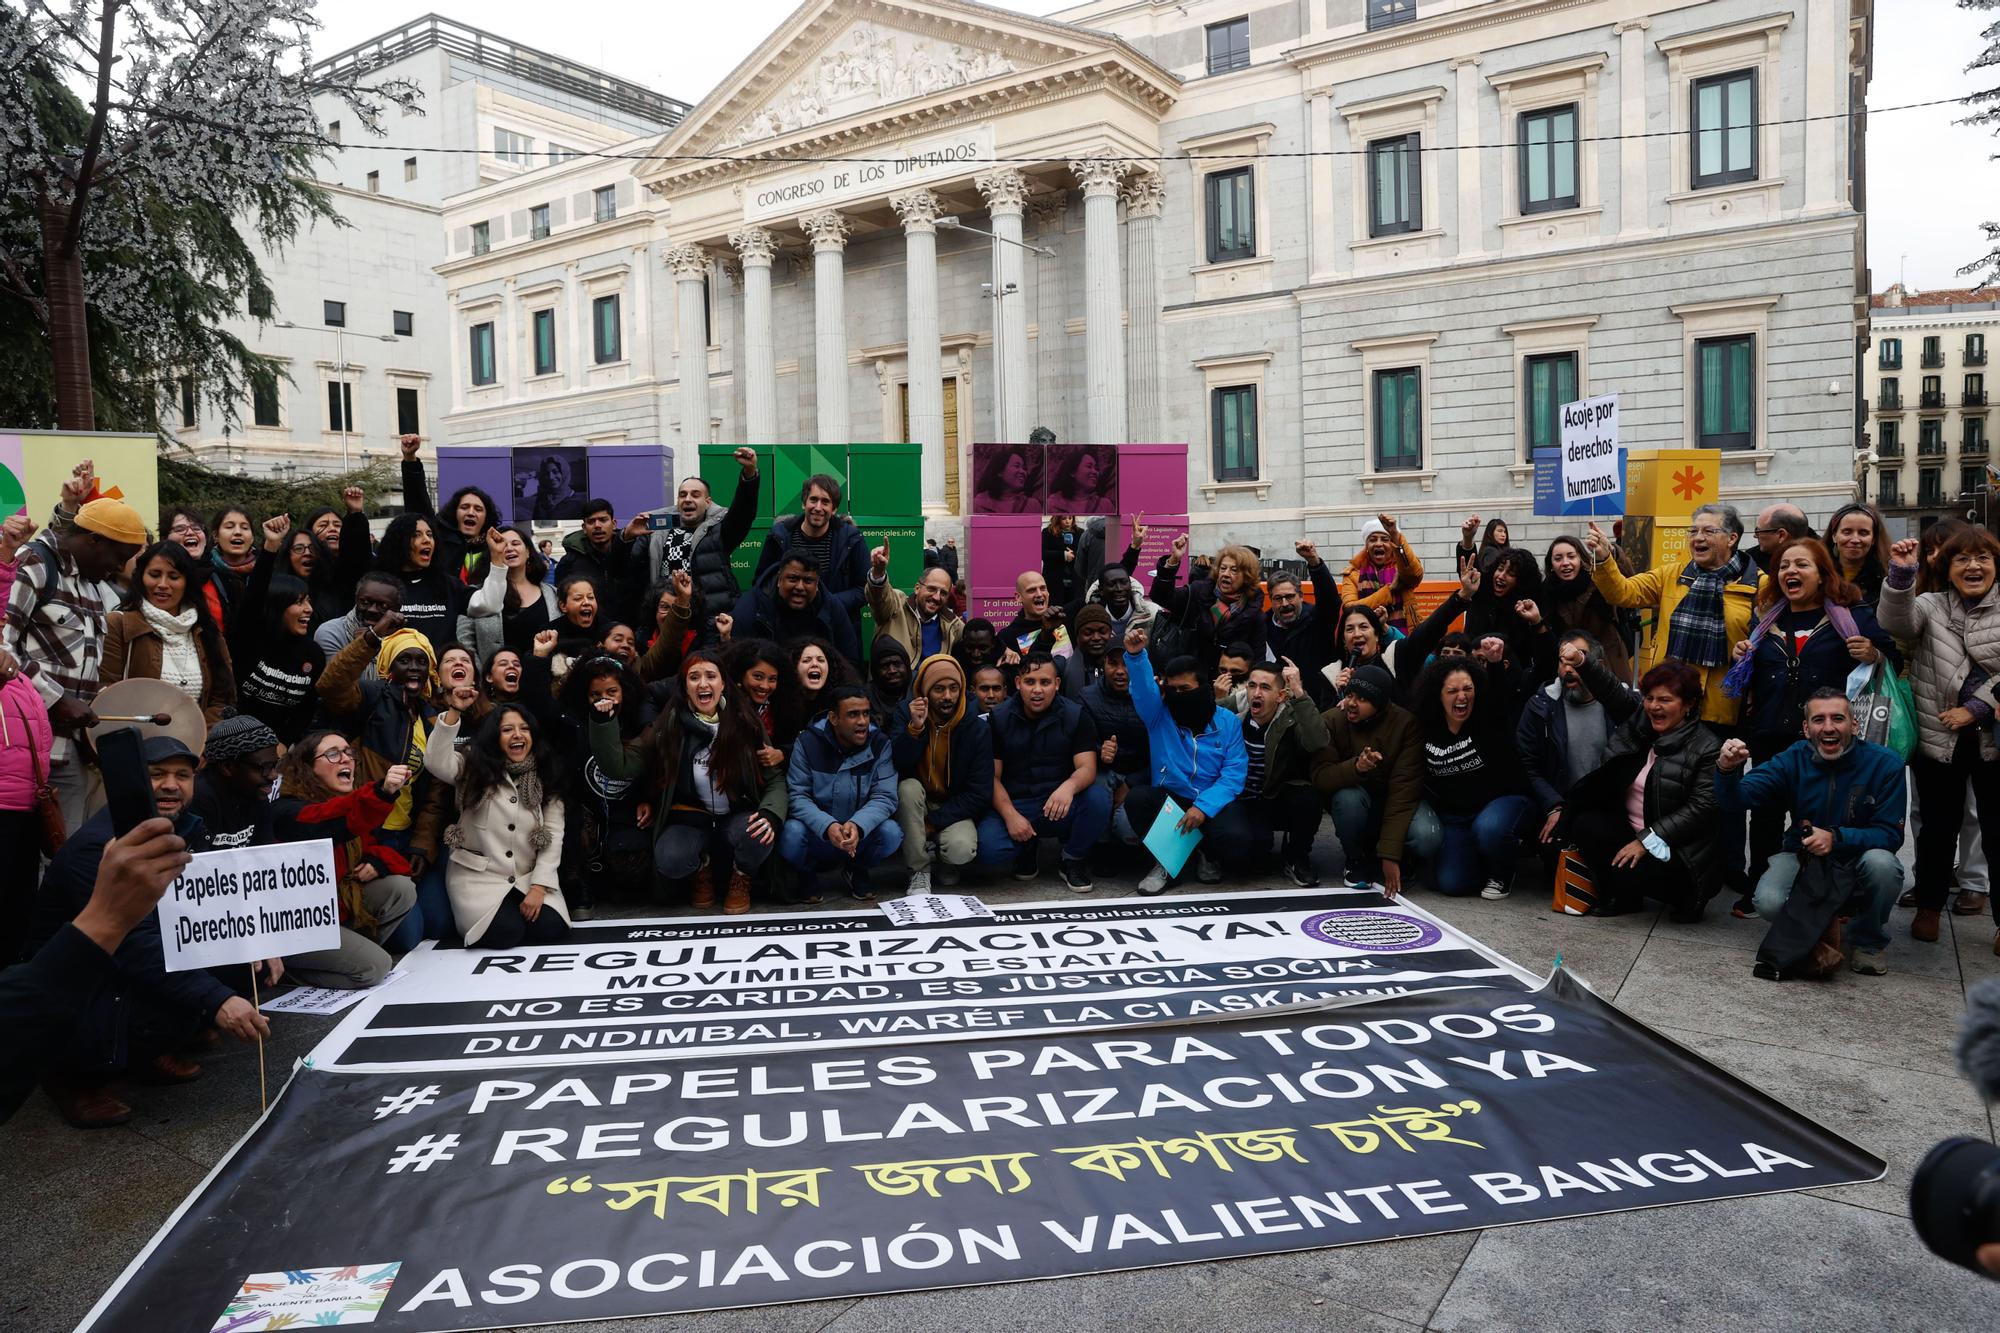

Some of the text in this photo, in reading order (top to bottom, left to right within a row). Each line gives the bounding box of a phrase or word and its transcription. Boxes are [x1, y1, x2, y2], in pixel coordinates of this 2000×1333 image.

[758, 143, 977, 207] CONGRESO DE LOS DIPUTADOS
[1564, 402, 1614, 430] Acoje por
[1568, 435, 1613, 462] derechos
[1567, 474, 1616, 498] humanos.
[740, 540, 761, 548] parte
[1662, 537, 1686, 549] cial
[242, 680, 258, 693] por
[1460, 755, 1483, 770] social
[174, 859, 330, 906] Papeles para todos.
[175, 898, 336, 952] ¡Derechos humanos!
[628, 905, 1229, 939] #RegularizacionYa #ILPRegularizacion
[471, 926, 1159, 975] REGULARIZACIÓN
[1171, 920, 1291, 941] YA!
[485, 959, 1384, 1018] NO ES CARIDAD, ES JUSTICIA SOCIAL
[606, 950, 1186, 990] MOVIMIENTO ESTATAL
[464, 1034, 544, 1053] DU
[559, 1022, 822, 1050] NDIMBAL,
[838, 1008, 1025, 1034] WARÉF
[1043, 1006, 1115, 1024] LA
[1123, 1001, 1175, 1018] CI
[373, 1004, 1556, 1120] # PAPELES PARA TODOS
[386, 1049, 1598, 1174] # REGULARIZACIÓN YA
[851, 1151, 1040, 1197] জন্য
[1051, 1127, 1310, 1182] কাগজ
[398, 1142, 1815, 1312] ASOCIACIÓN VALIENTE BANGLA
[257, 1295, 363, 1308] VALIENTE BANGLA
